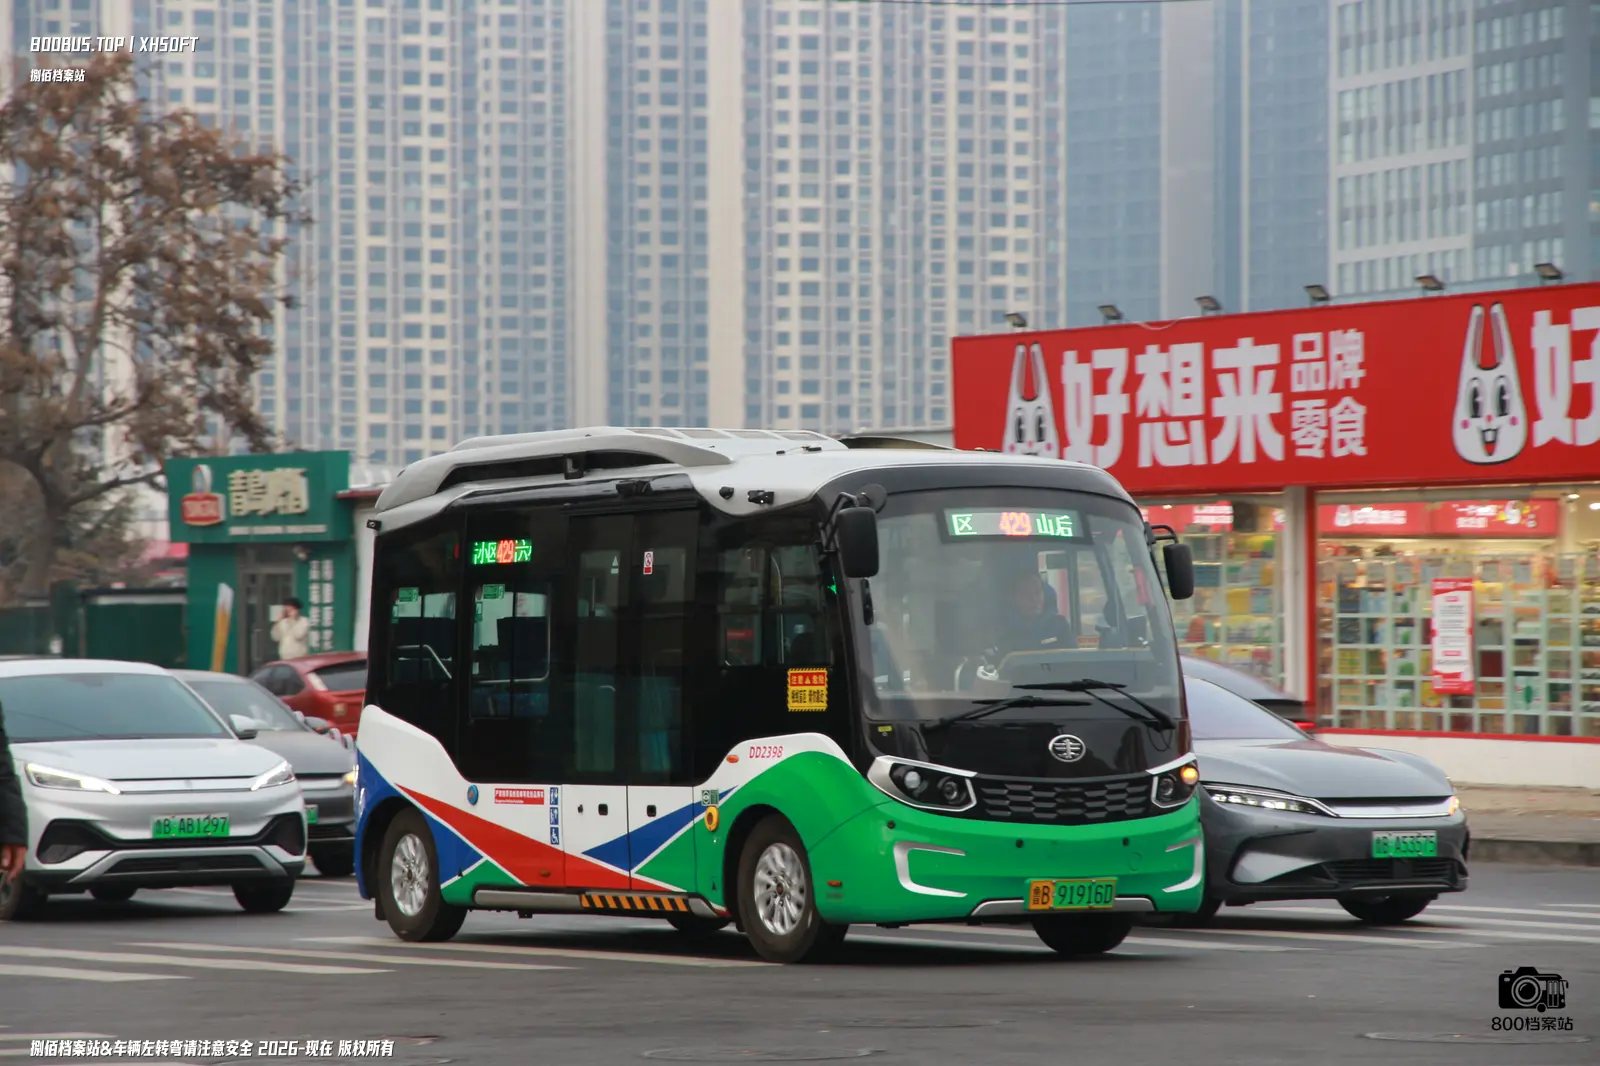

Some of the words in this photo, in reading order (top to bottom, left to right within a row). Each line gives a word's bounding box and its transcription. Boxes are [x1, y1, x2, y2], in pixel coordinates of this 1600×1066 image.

[1290, 328, 1367, 392] 品牌
[1530, 306, 1600, 448] 好
[1062, 336, 1285, 470] 好想来
[1290, 396, 1368, 458] 零食
[497, 540, 514, 563] 429
[999, 512, 1032, 536] 429
[749, 745, 783, 759] DD2398
